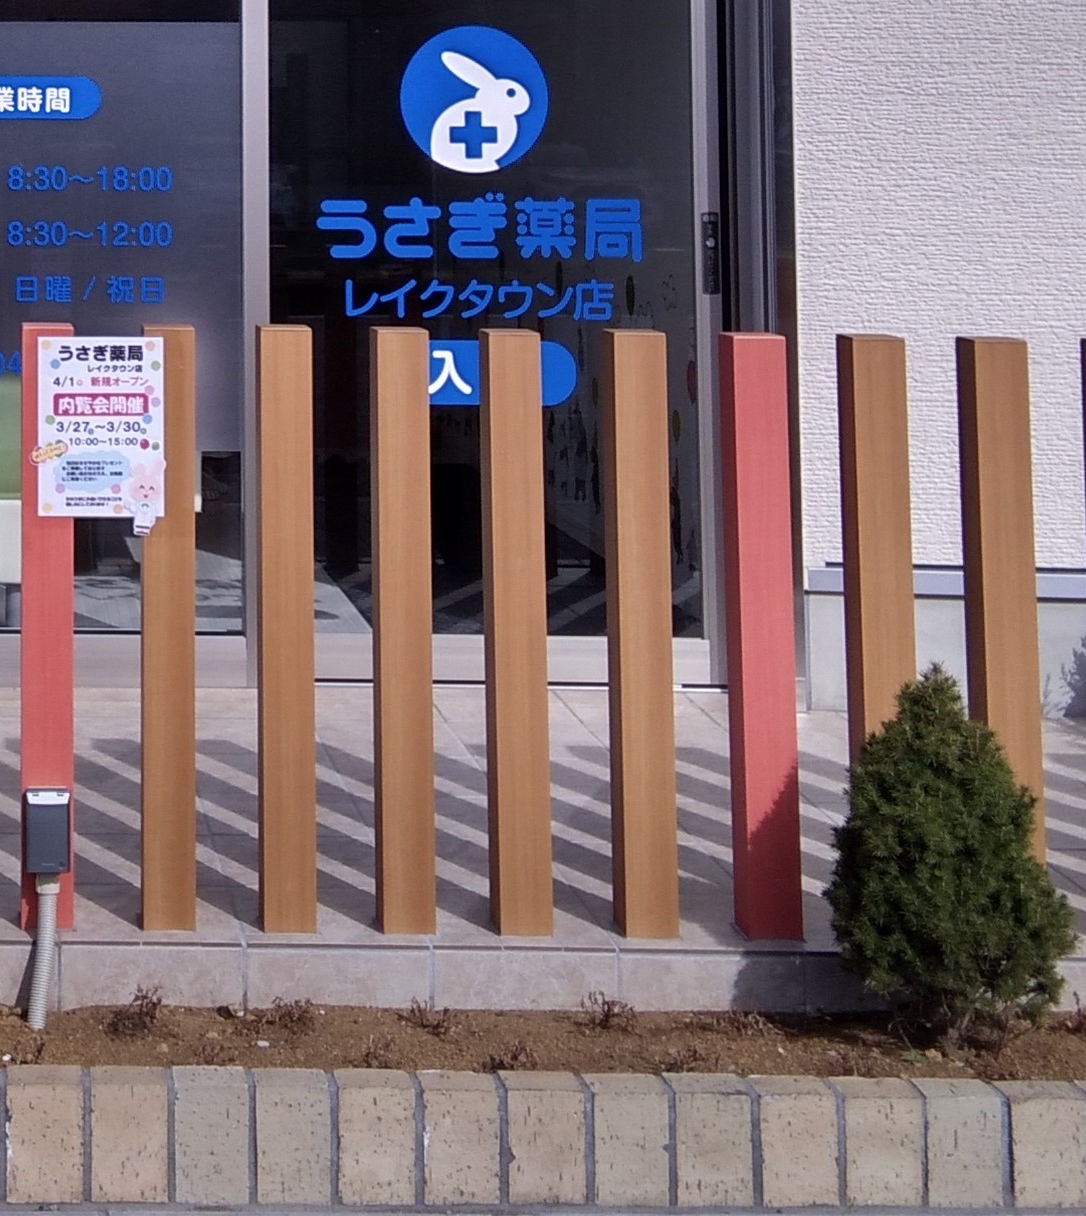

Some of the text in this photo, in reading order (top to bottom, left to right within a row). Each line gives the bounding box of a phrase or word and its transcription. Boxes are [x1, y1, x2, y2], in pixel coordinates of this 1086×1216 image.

[316, 192, 644, 263] うさぎ薬局
[344, 279, 614, 321] レイクタウン店
[58, 345, 144, 362] うさぎ薬局
[87, 365, 143, 373] レイクタウン店
[90, 376, 149, 387] 新規オープン
[58, 395, 145, 415] 内覧会開催
